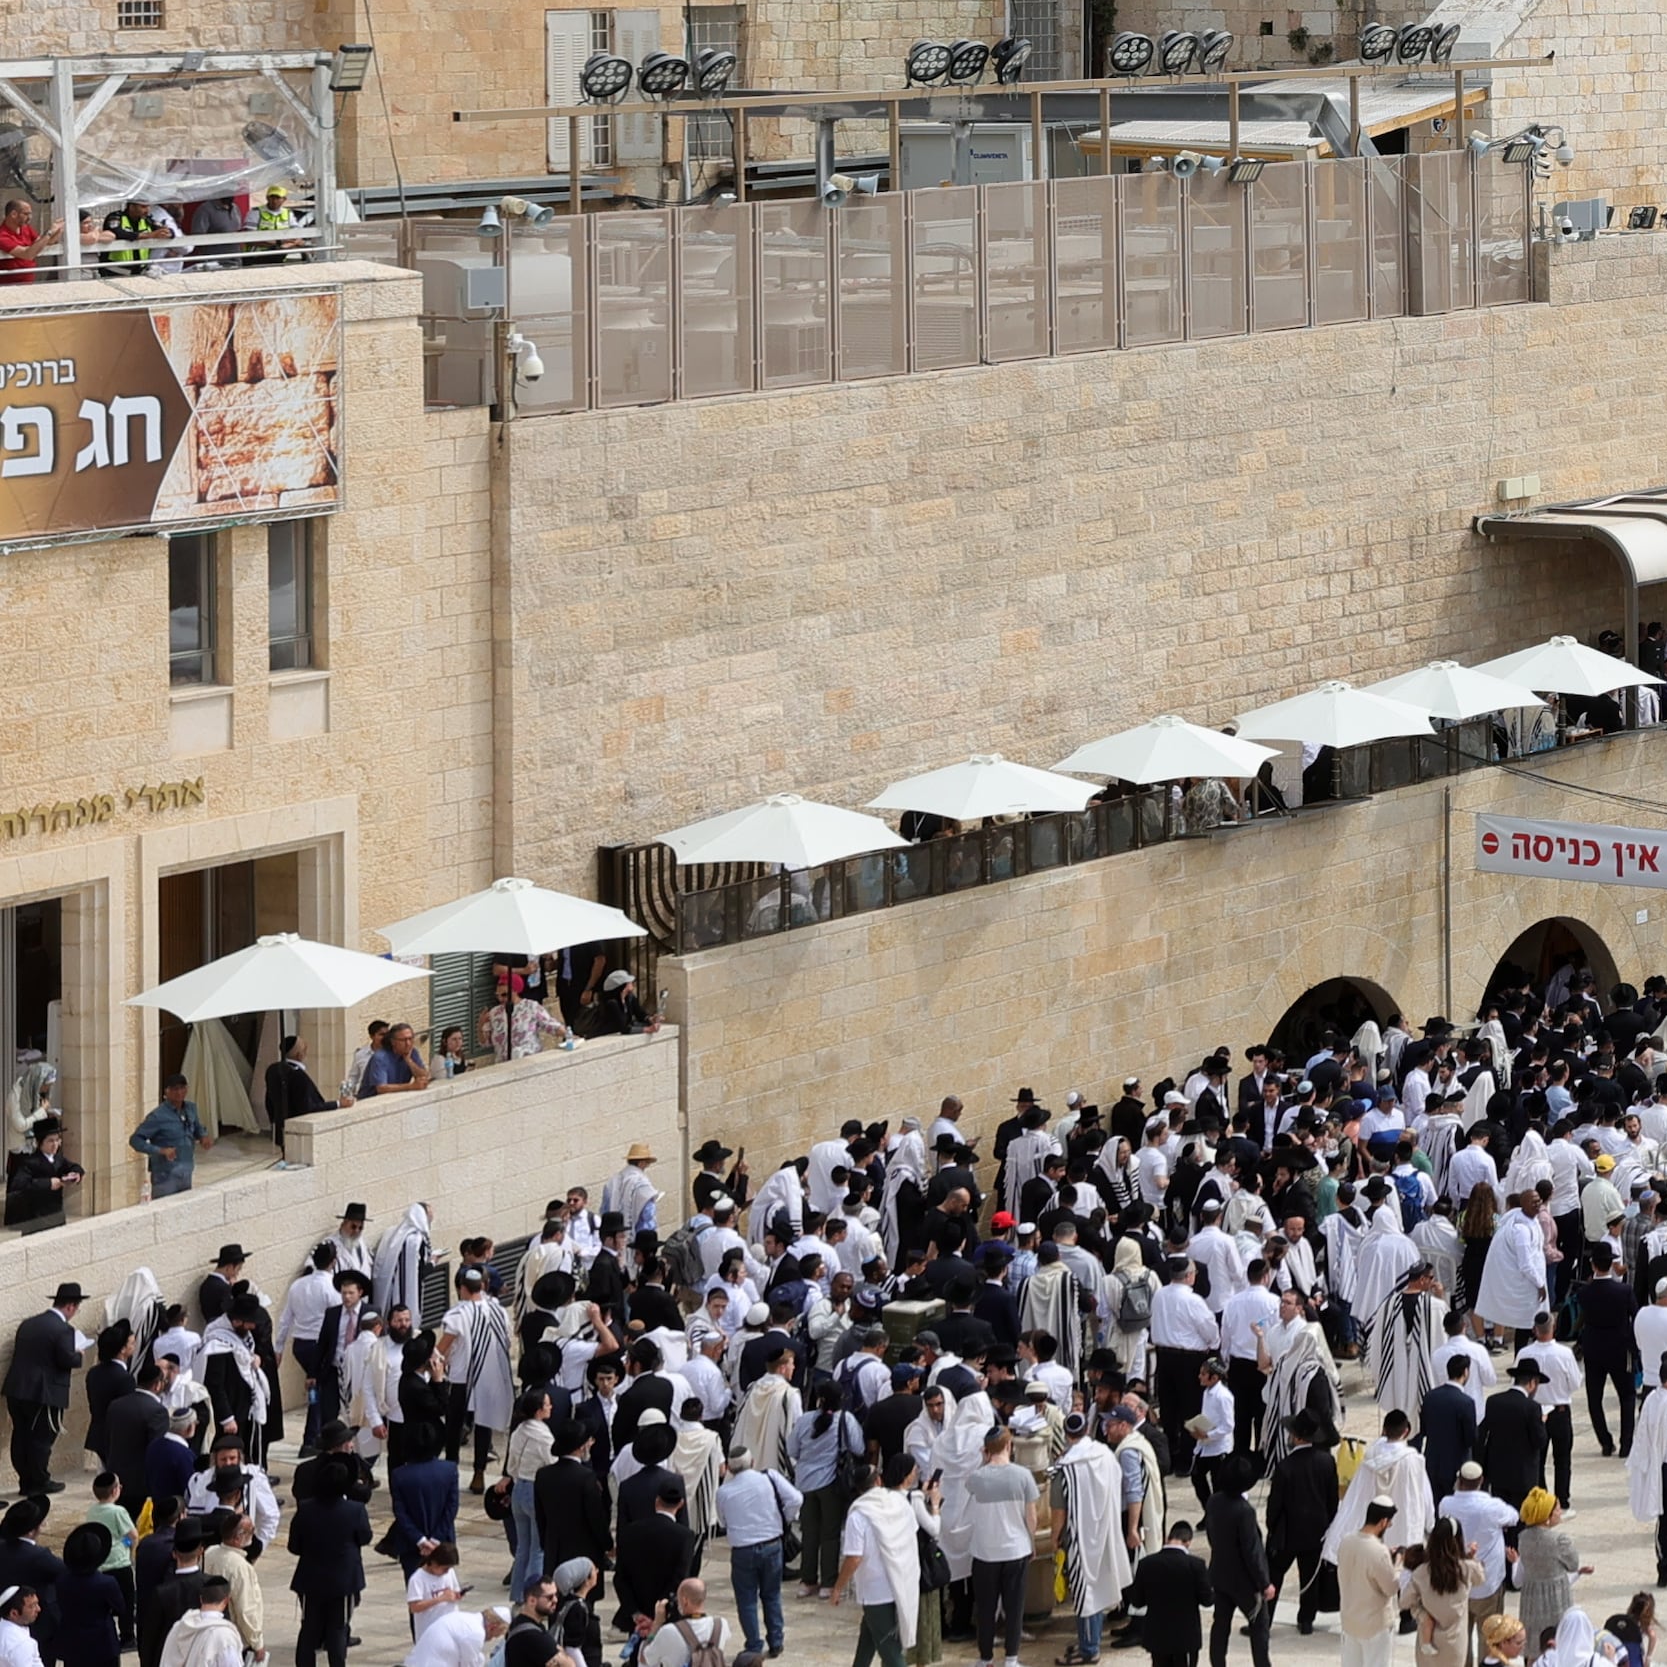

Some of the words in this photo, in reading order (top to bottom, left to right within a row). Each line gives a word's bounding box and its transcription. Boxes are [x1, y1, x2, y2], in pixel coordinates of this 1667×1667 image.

[76, 395, 162, 472] חג
[125, 776, 205, 812] אתרי
[0, 793, 116, 839] מנהרות
[1512, 833, 1601, 867] כניסה
[1613, 842, 1659, 875] אין
